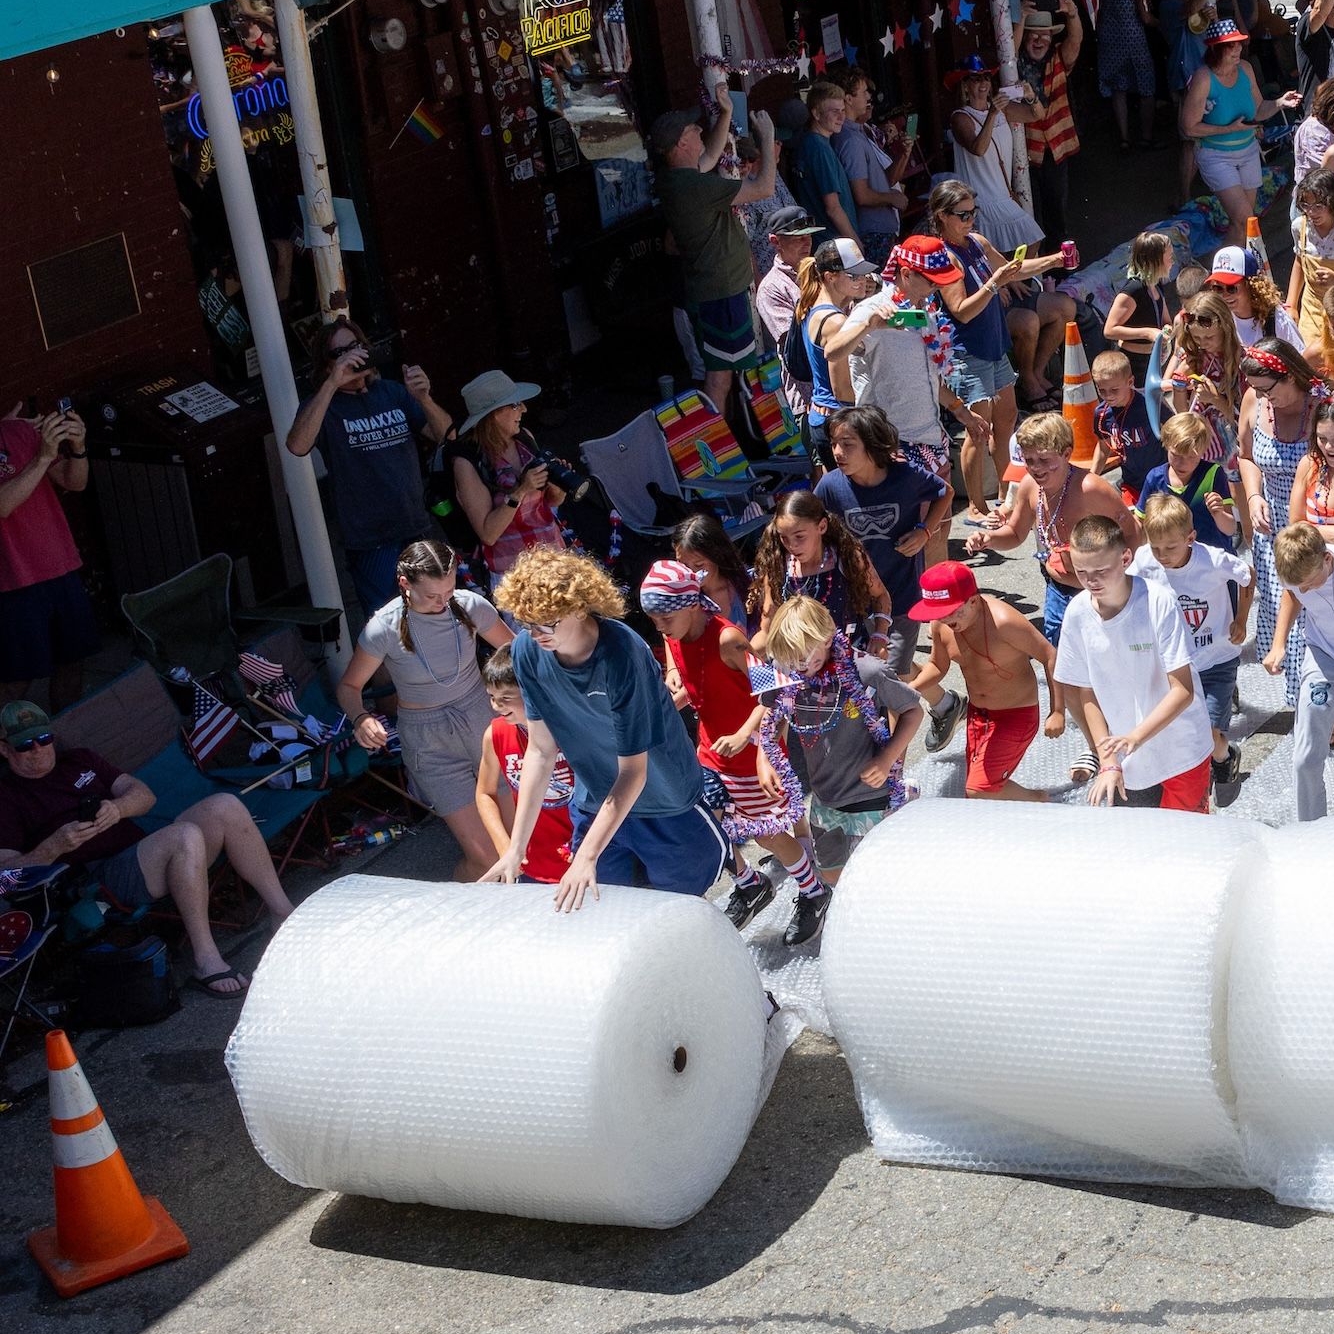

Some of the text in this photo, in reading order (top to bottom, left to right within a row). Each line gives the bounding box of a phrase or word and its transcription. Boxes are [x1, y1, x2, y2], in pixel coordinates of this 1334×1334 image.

[520, 7, 591, 54] PACIFICO
[187, 78, 290, 139] Crona
[136, 376, 178, 396] TRASH
[348, 434, 358, 445] &
[359, 430, 385, 443] OVER
[1194, 633, 1213, 648] FUN
